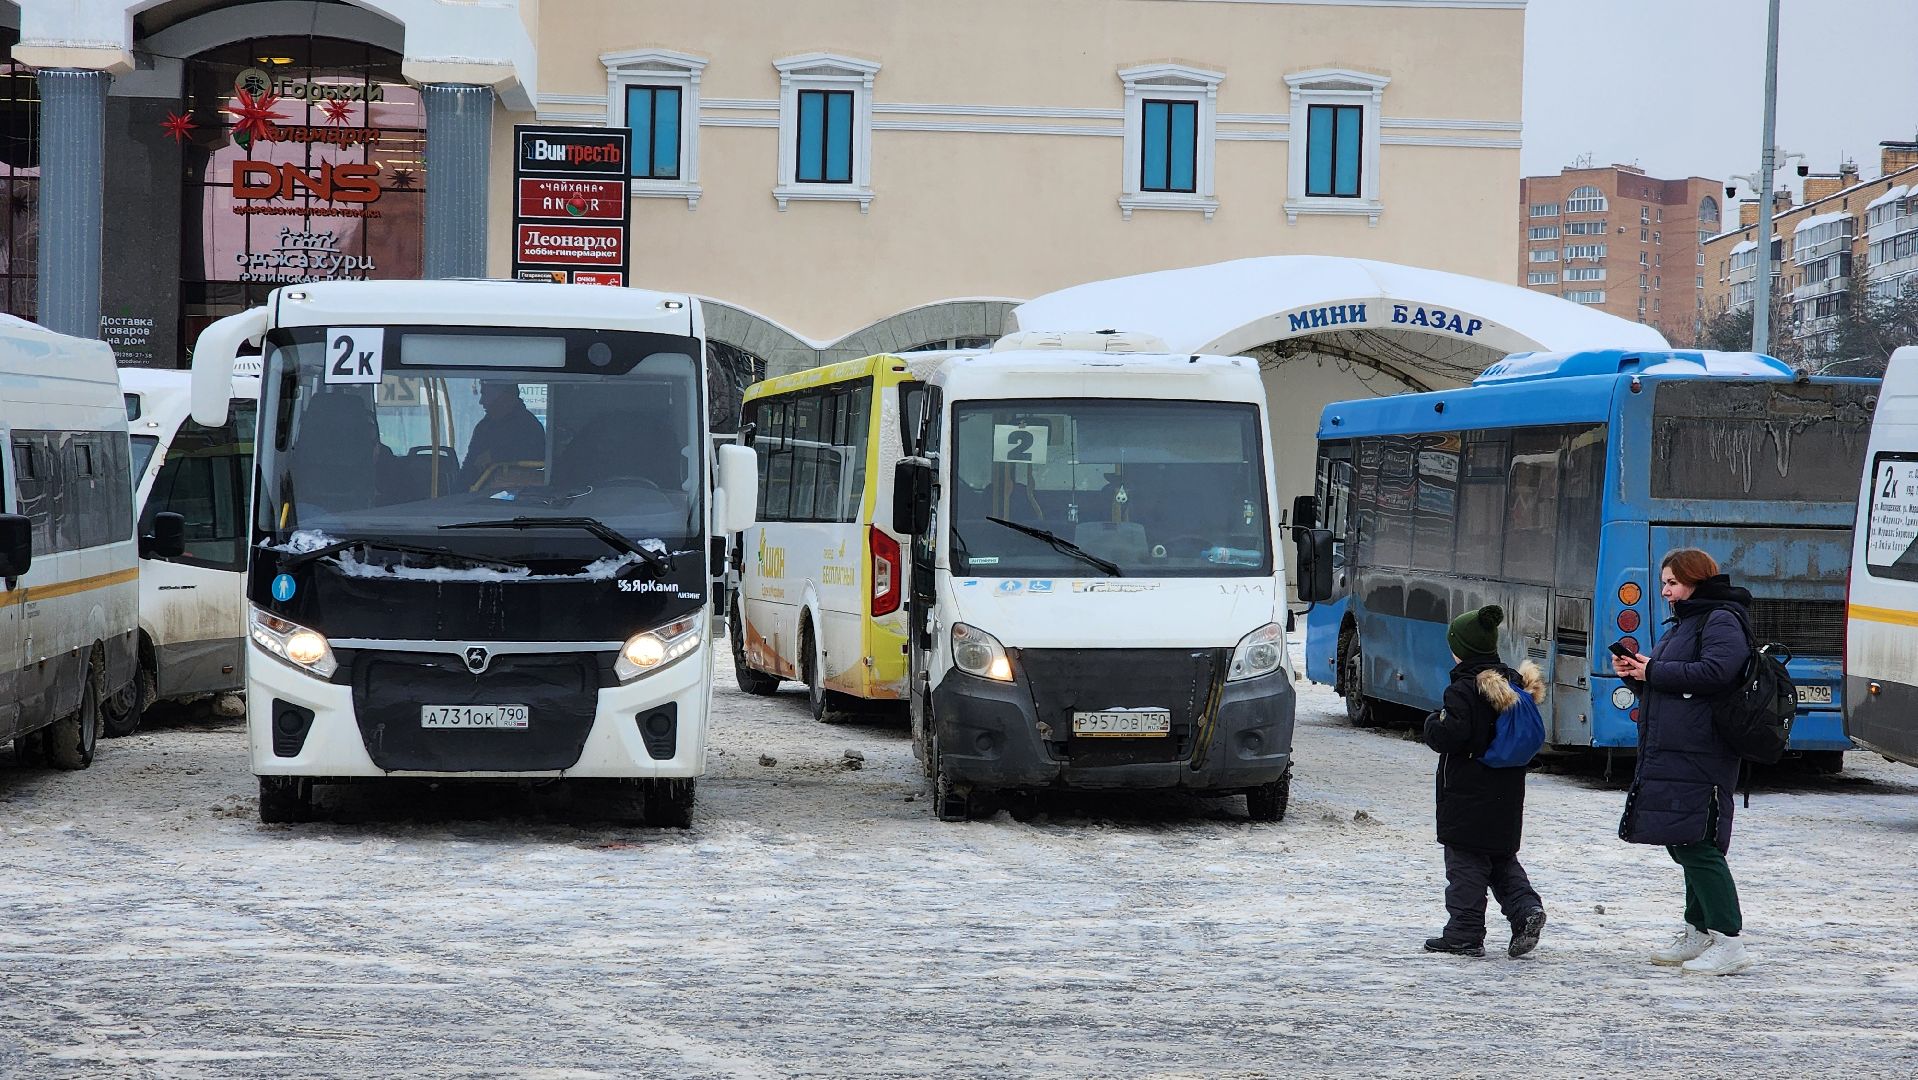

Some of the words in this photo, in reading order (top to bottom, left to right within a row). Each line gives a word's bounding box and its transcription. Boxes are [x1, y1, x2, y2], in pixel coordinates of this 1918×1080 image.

[277, 76, 384, 106] Горький
[256, 123, 382, 150] аламарт
[233, 160, 381, 203] DNS
[546, 181, 597, 193] ЧАЙХАНА
[524, 231, 617, 250] Леонардо
[524, 248, 617, 258] хобби-гипермаркет
[236, 252, 376, 275] оджахури
[101, 315, 153, 326] Доставка
[1288, 304, 1367, 332] МИНИ
[1391, 304, 1482, 336] БАЗАР
[104, 327, 150, 337] товаров
[107, 337, 120, 345] на
[123, 338, 146, 346] дом
[1006, 430, 1034, 462] 2
[632, 579, 679, 593] ЯрКамп
[428, 708, 494, 725] А731ОК
[498, 707, 524, 721] 790
[1078, 714, 1139, 730] Р957ОВ
[1142, 714, 1166, 726] 750
